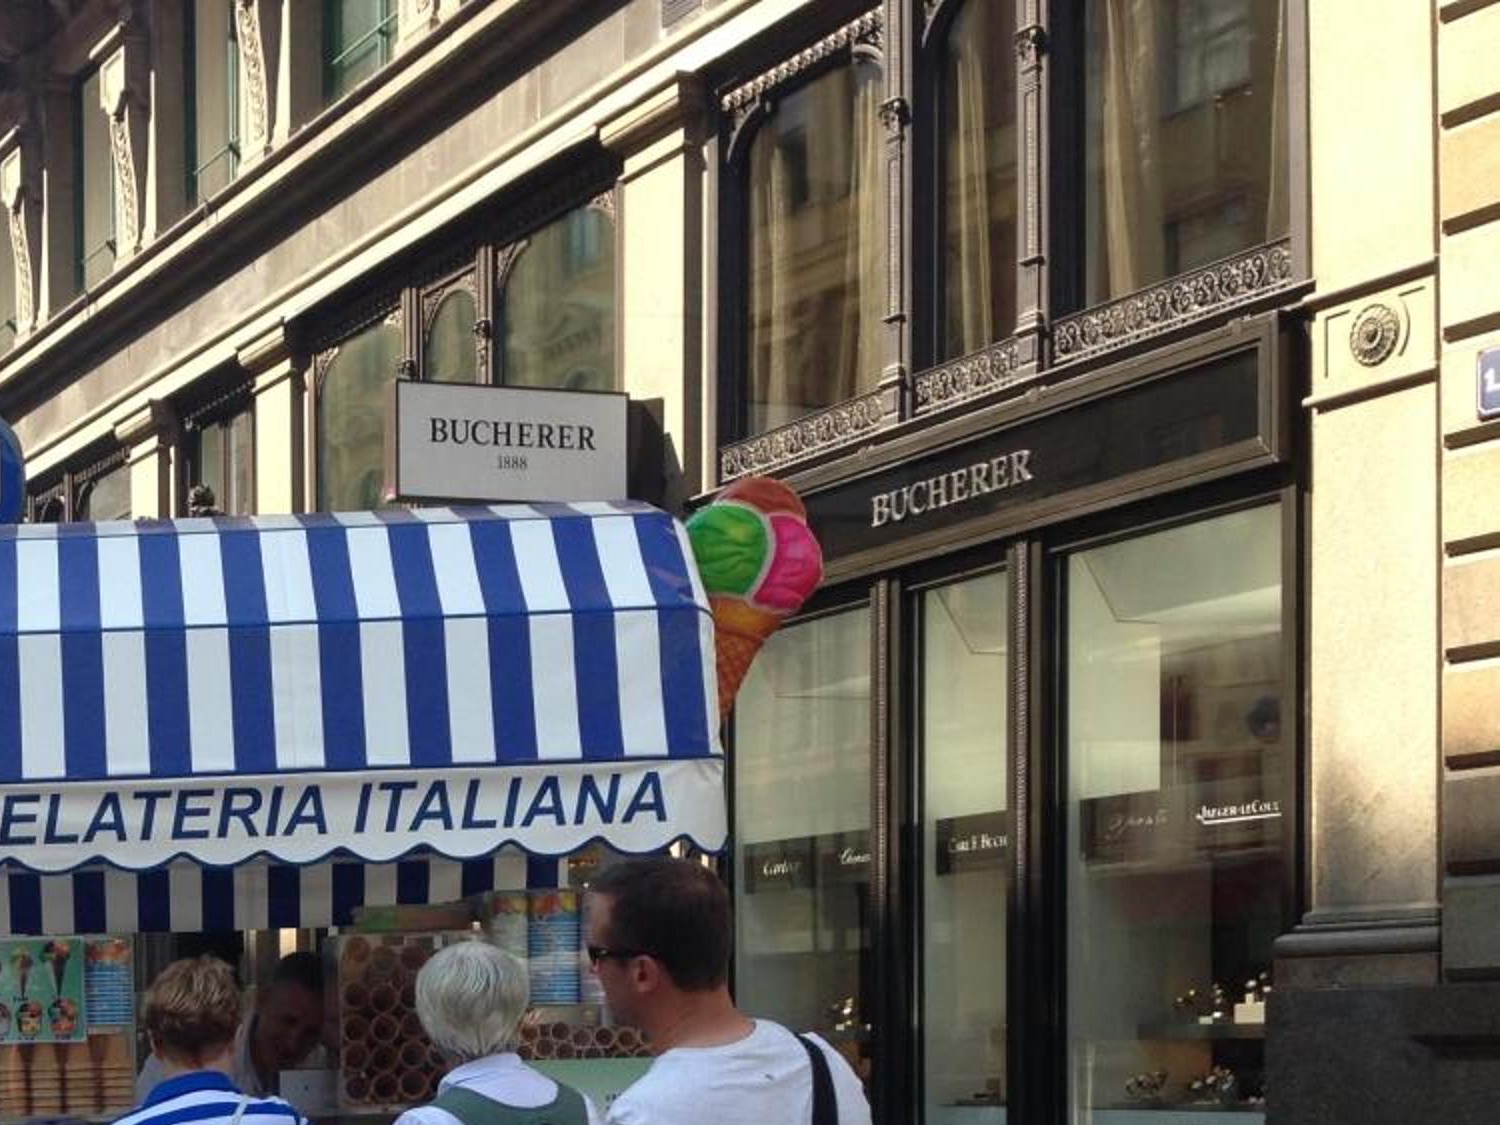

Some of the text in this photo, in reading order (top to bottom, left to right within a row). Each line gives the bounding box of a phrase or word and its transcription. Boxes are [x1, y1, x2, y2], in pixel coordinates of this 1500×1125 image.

[430, 417, 597, 451] BUCHERER
[497, 455, 528, 470] 1888
[871, 449, 1035, 528] BUCHERER
[353, 771, 667, 833] ITALIANA
